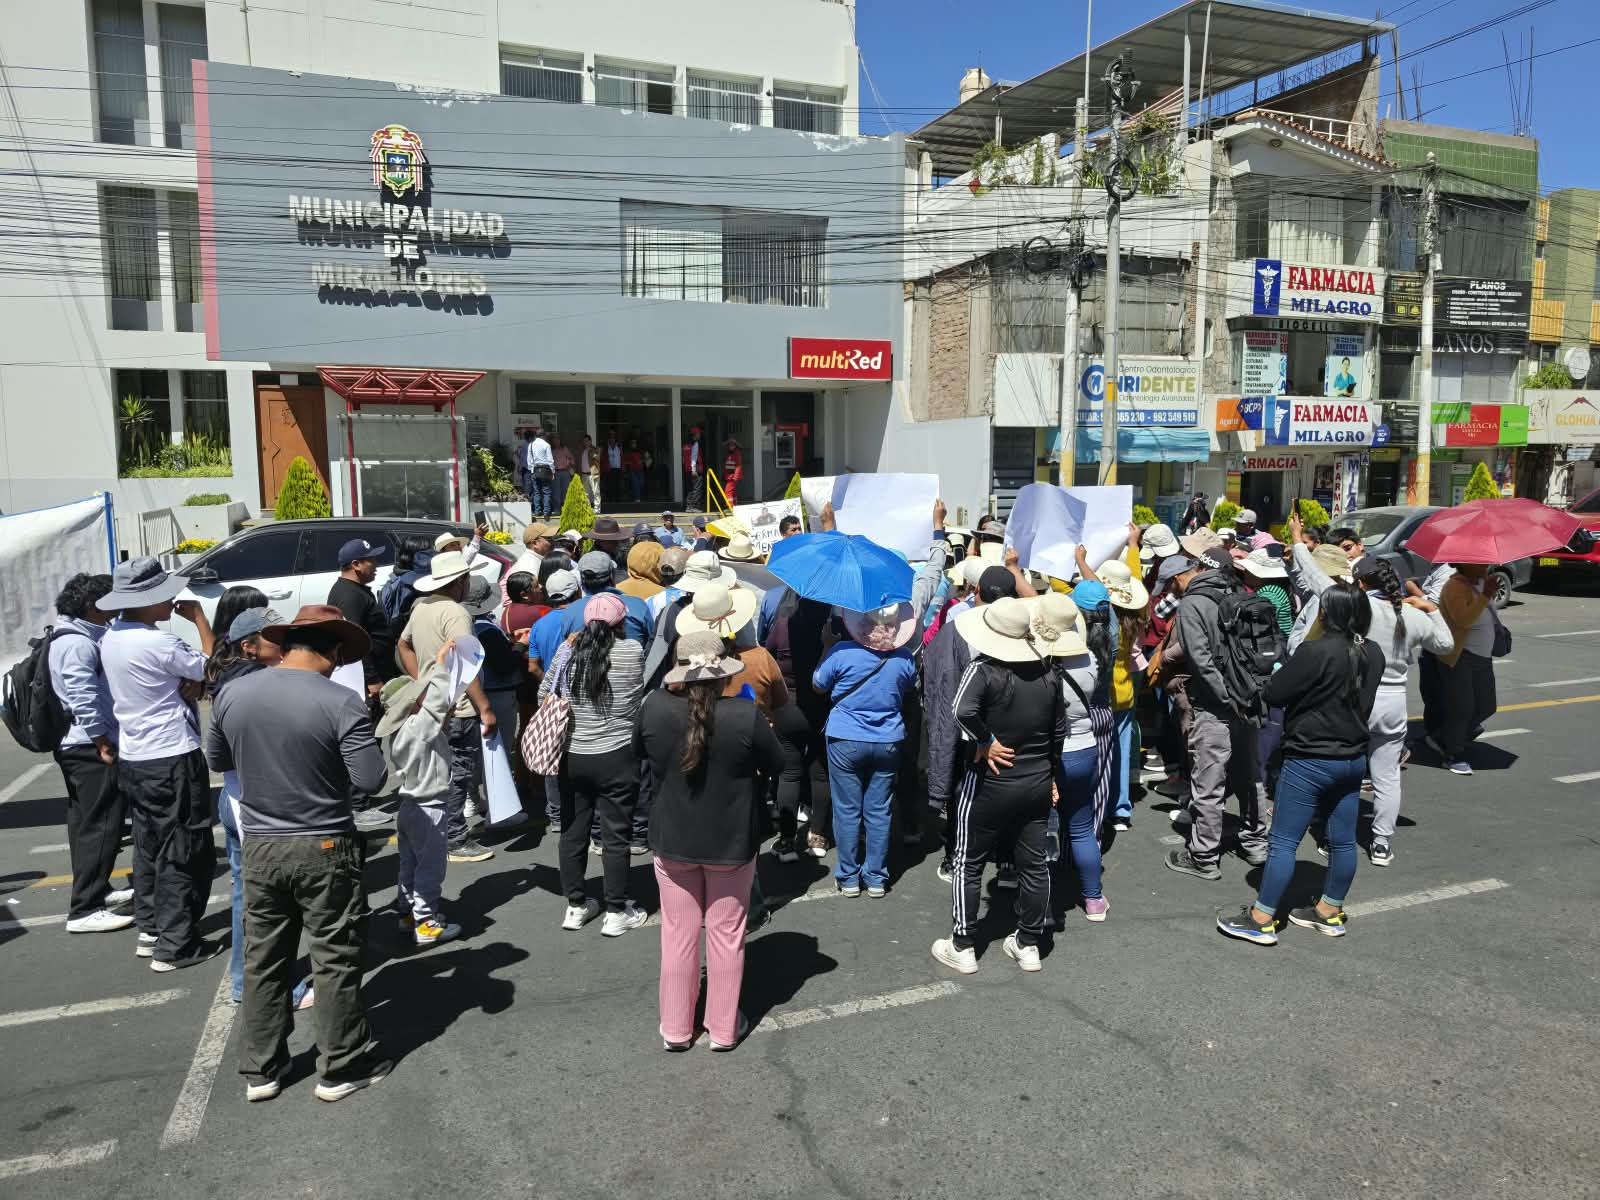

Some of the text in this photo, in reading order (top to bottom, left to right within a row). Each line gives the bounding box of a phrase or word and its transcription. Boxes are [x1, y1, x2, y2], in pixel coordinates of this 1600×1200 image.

[289, 195, 504, 236] MUNICIPALIDAD
[383, 233, 419, 258] DE
[1288, 266, 1375, 295] FARMACIA
[1291, 297, 1372, 315] MILAGRO
[800, 350, 882, 369] multiRed
[1294, 405, 1368, 422] FARMACIA
[1295, 430, 1365, 442] MILAGRO
[1244, 457, 1297, 469] RMACIA
